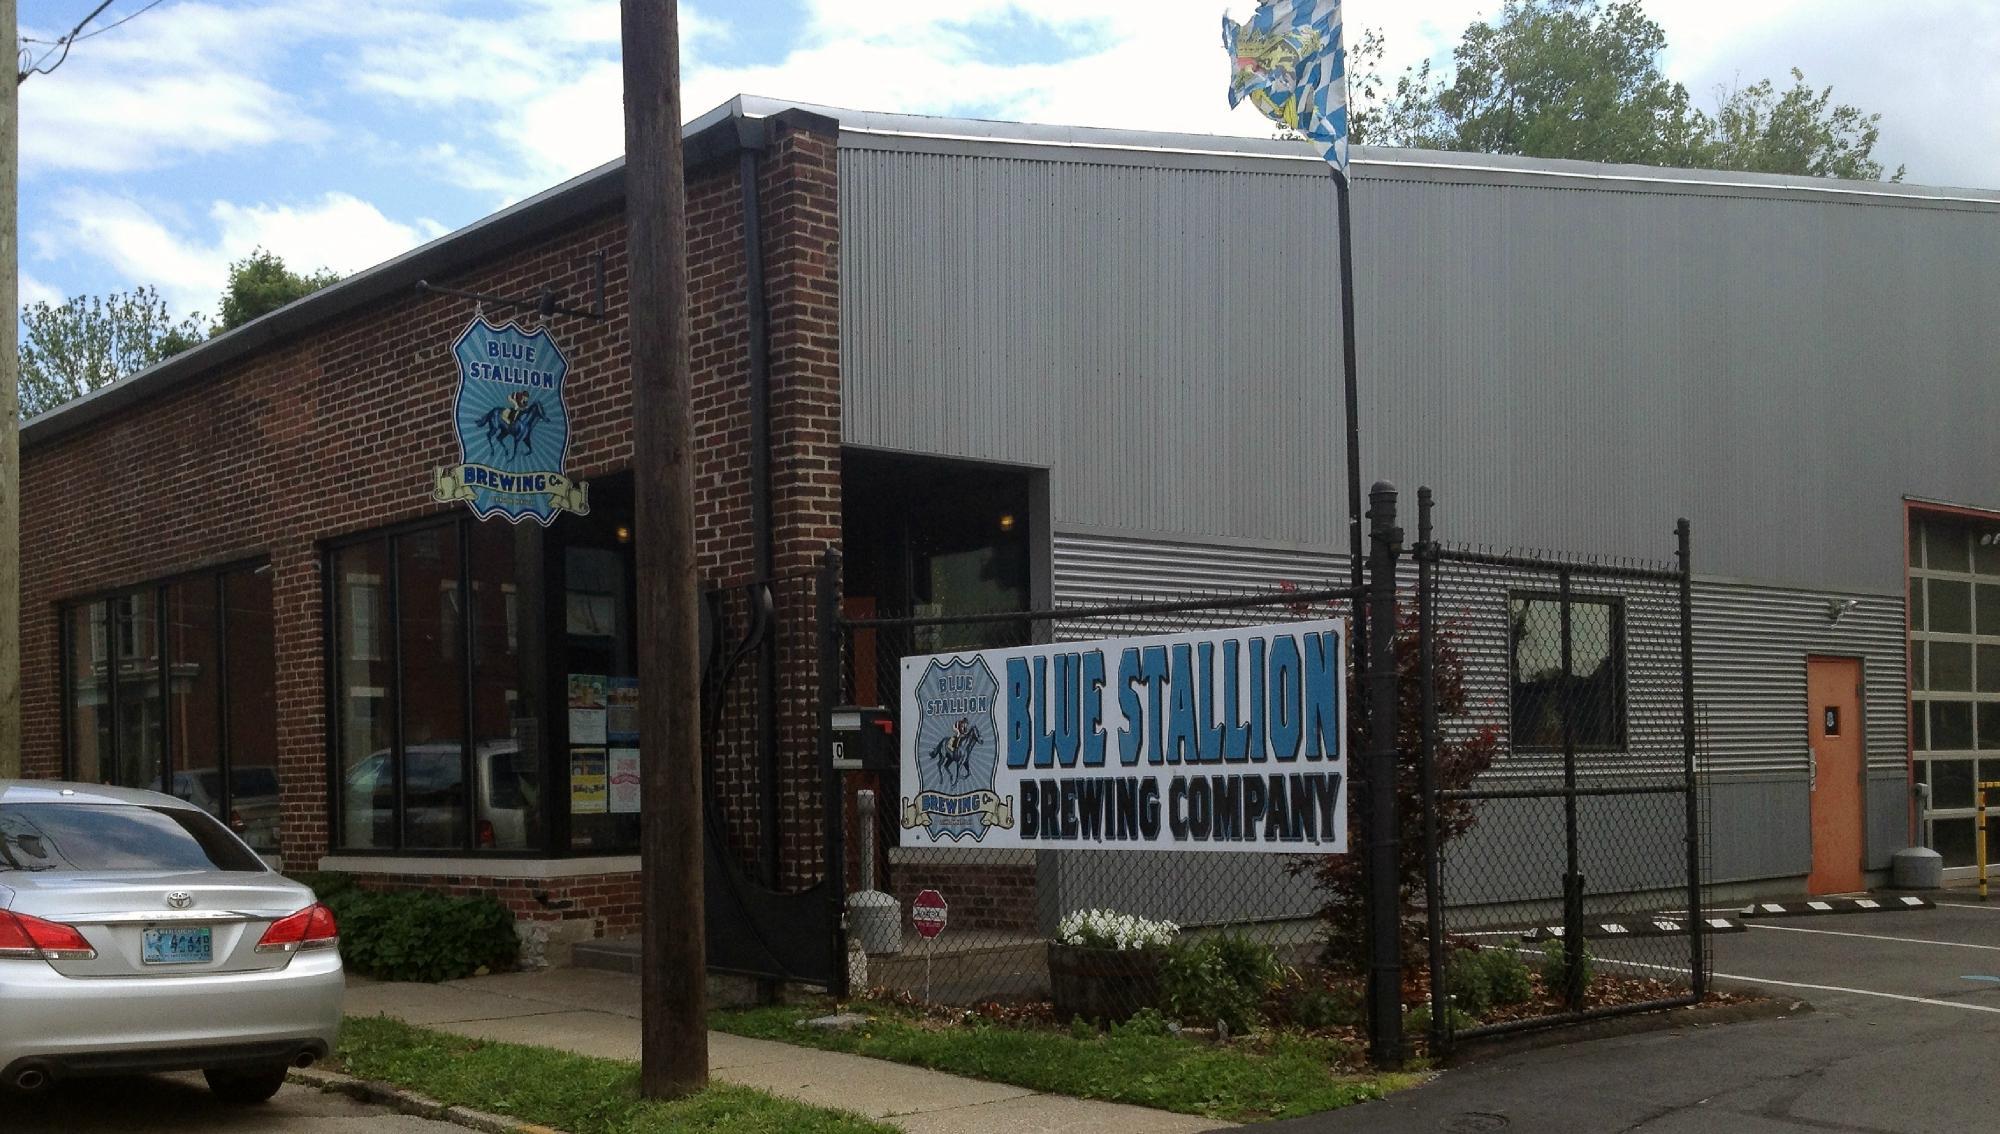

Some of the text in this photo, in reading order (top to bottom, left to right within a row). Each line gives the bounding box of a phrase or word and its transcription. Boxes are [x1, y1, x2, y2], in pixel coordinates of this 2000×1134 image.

[487, 340, 537, 364] BLUE
[470, 362, 554, 389] STALLION
[464, 466, 546, 492] BREWING
[938, 675, 974, 693] BLUE
[926, 695, 987, 715] STALLION
[1006, 631, 1340, 769] BLUE STALLION
[921, 794, 980, 814] BREWING
[1020, 772, 1342, 842] BREWING COMPANY
